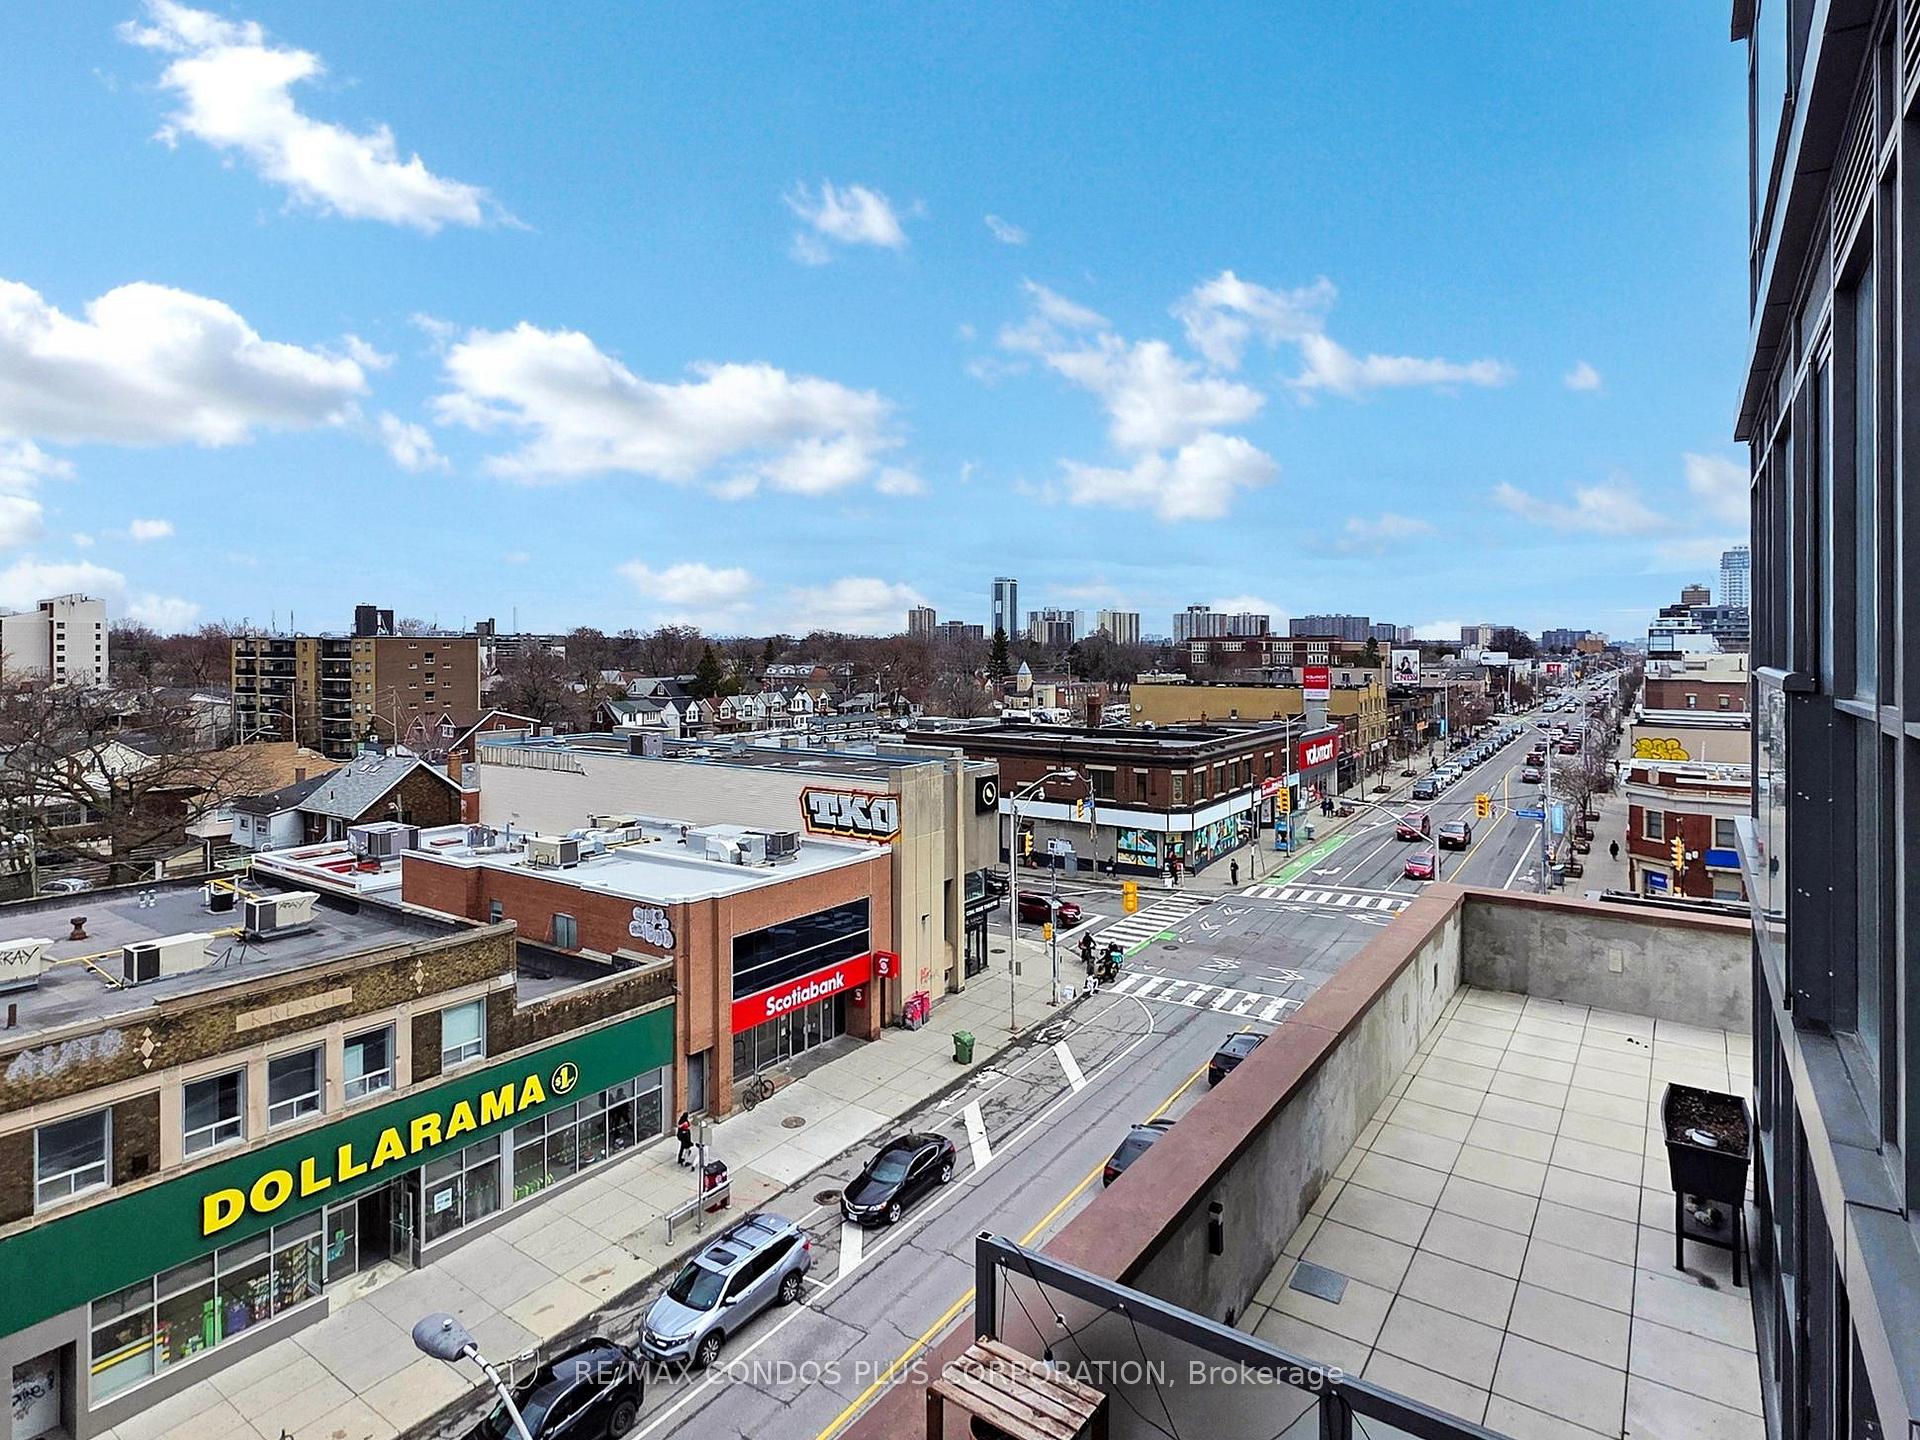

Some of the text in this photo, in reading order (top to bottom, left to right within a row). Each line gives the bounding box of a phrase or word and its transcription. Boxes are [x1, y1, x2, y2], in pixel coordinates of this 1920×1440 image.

[805, 790, 901, 837] TKO
[766, 972, 845, 1016] Scotiabank
[203, 1074, 546, 1236] DOLLARAMA
